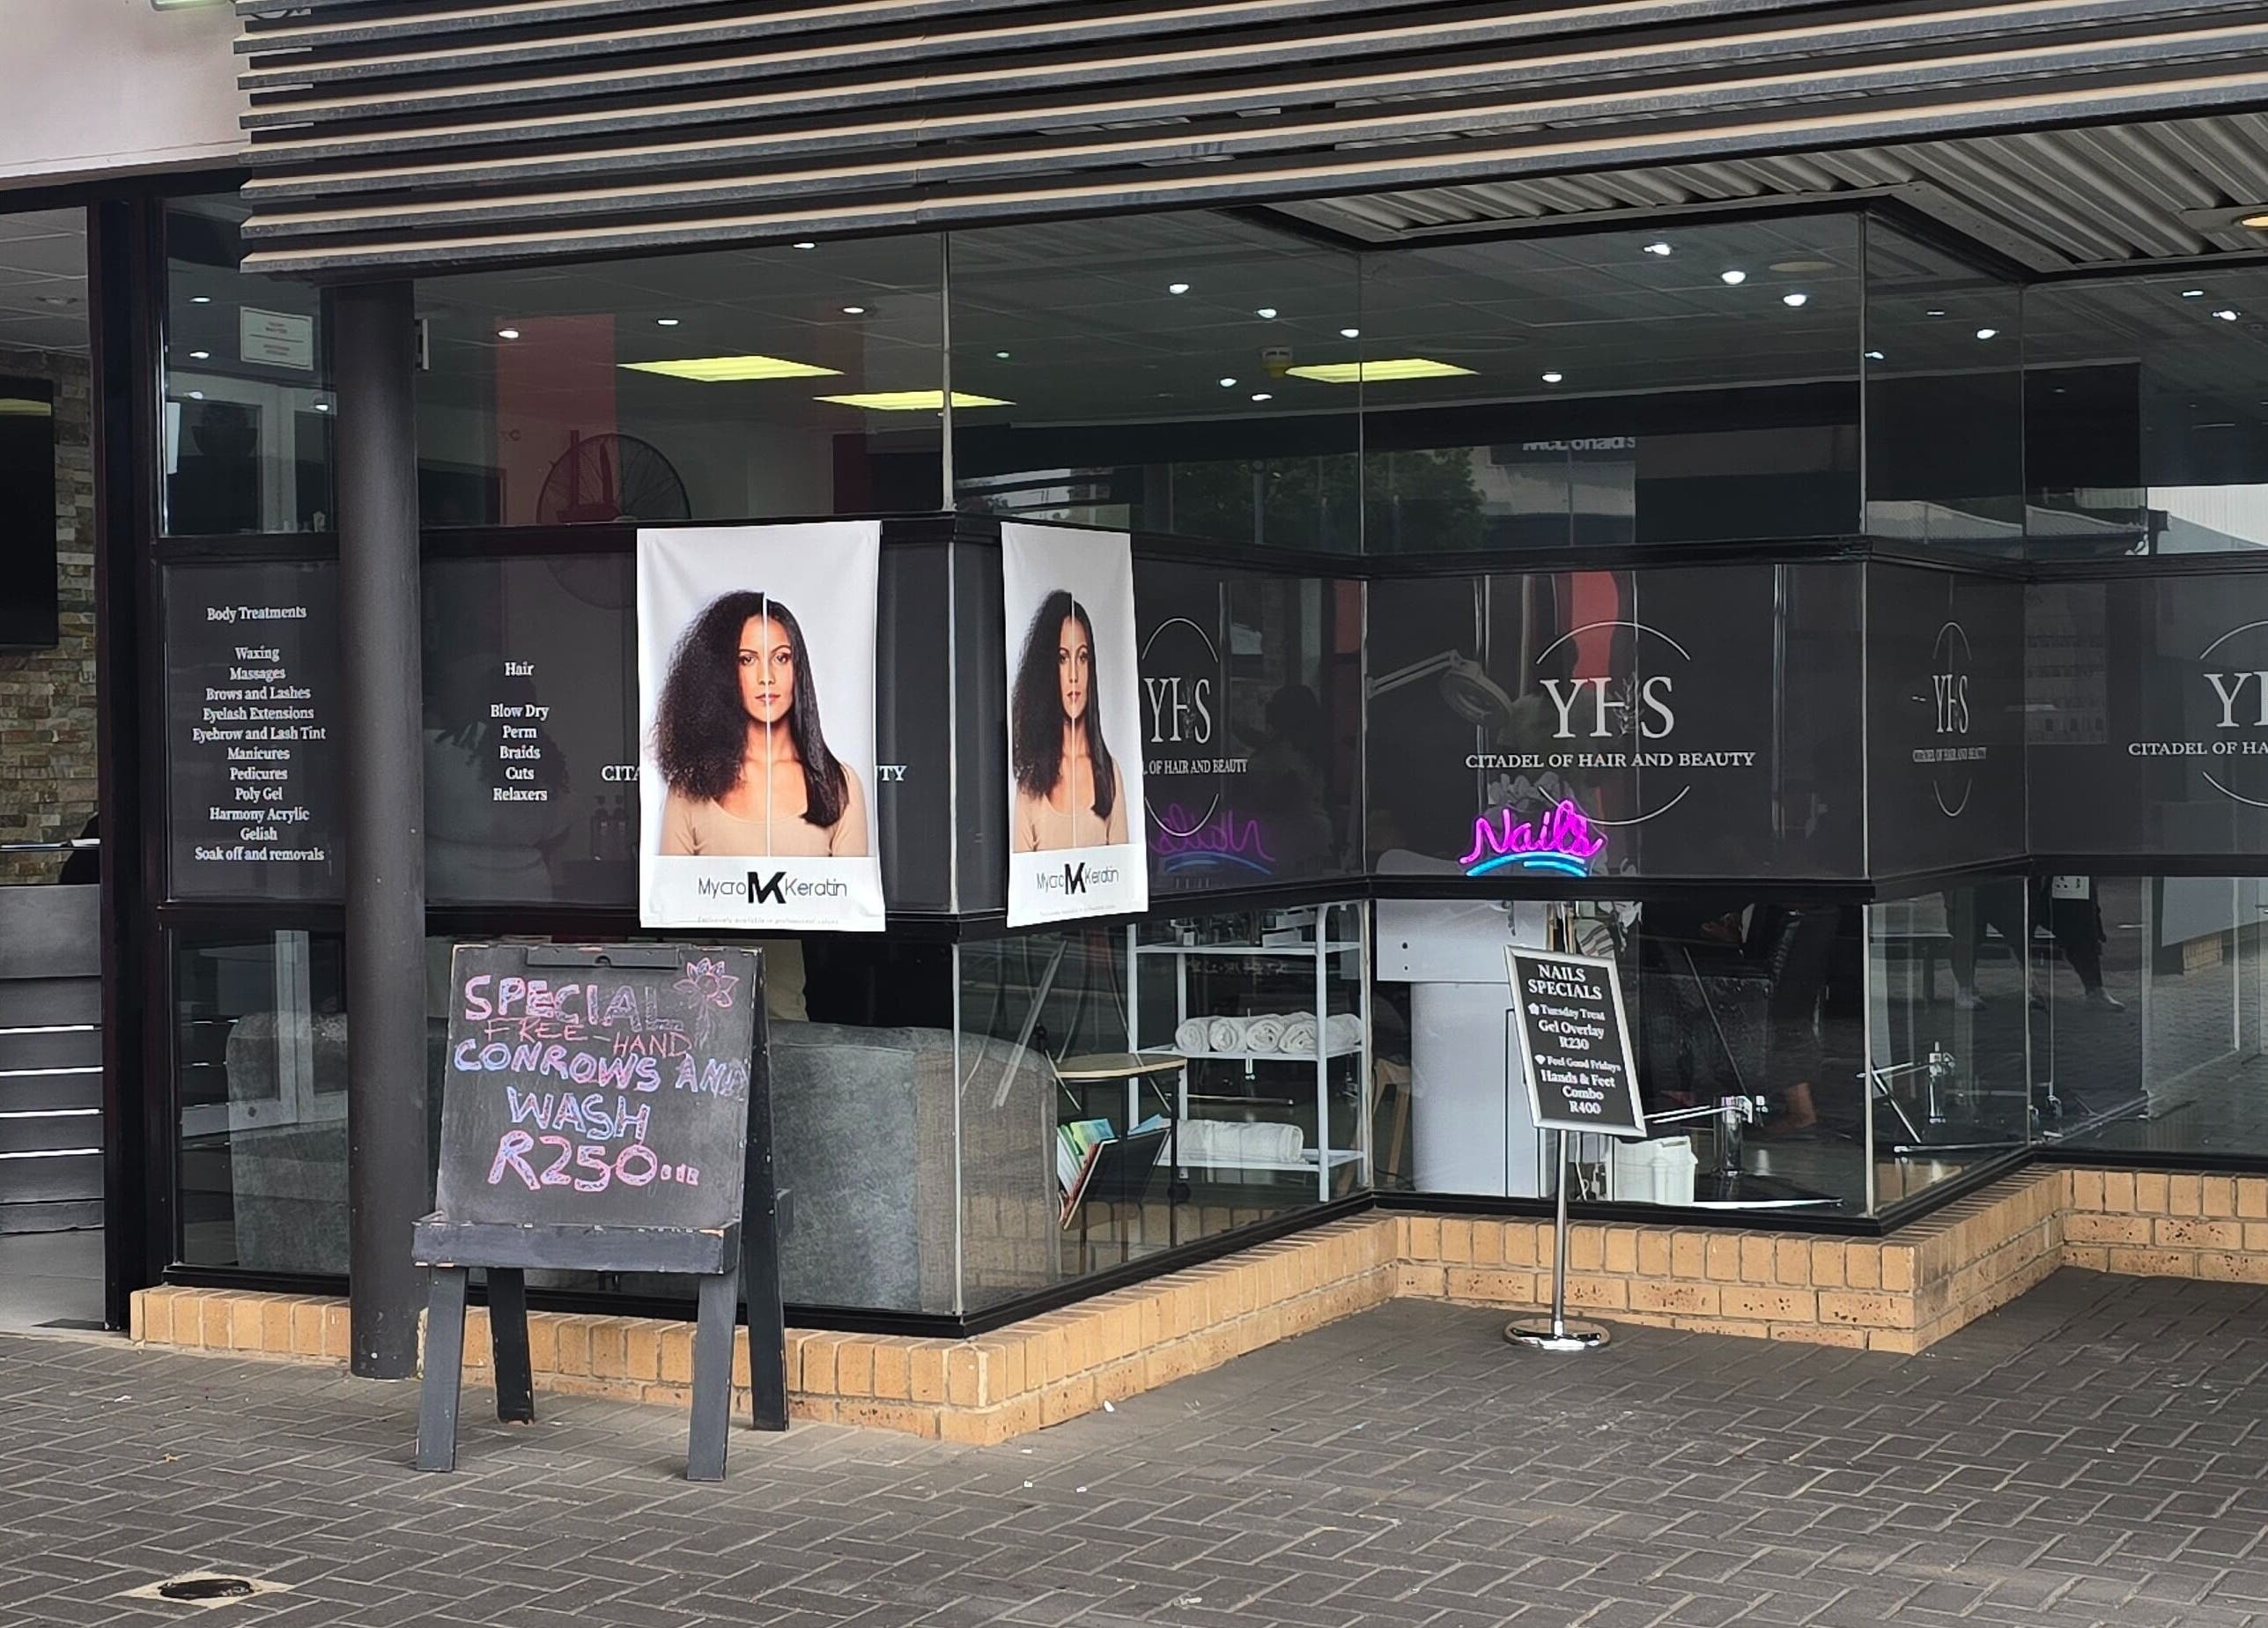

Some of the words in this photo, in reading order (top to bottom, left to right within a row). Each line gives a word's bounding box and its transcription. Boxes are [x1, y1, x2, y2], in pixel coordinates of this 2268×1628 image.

[206, 606, 236, 624] Body
[238, 605, 307, 619] Treatments
[234, 645, 280, 662] Waxing
[229, 667, 286, 683] Massages
[505, 661, 535, 676] Hair
[205, 687, 243, 701] Brows
[244, 685, 268, 700] and
[270, 684, 312, 699] Lashes
[203, 707, 247, 723] Eyelash
[249, 706, 314, 720] Extensions
[490, 703, 523, 718] Blow
[525, 704, 550, 722] Dry
[1143, 677, 1211, 744] YHS
[1540, 676, 1674, 738] YHS
[192, 727, 244, 744] Eyebrow
[245, 726, 268, 740] and
[270, 726, 299, 740] Lash
[300, 725, 327, 740] Tint
[502, 725, 537, 739] Perm
[226, 746, 291, 760] Manicures
[499, 744, 541, 759] Braids
[2128, 742, 2208, 756] CITADEL
[2212, 742, 2238, 755] OF
[2242, 741, 2268, 755] HA
[1149, 759, 1163, 775] OF
[1164, 759, 1189, 774] HAIR
[1190, 759, 1211, 773] AND
[1212, 758, 1248, 773] BEAUTY
[1465, 754, 1544, 768] CITADEL
[1548, 753, 1573, 768] OF
[1577, 753, 1627, 767] HAIR
[1631, 752, 1673, 767] AND
[1678, 751, 1756, 767] BEAUTY
[230, 766, 288, 781] Pedicures
[505, 766, 535, 780] Cuts
[234, 786, 261, 803] Poly
[262, 787, 283, 801] Gel
[493, 787, 548, 802] Relaxers
[209, 807, 266, 824] Harmony
[267, 806, 310, 825] Acrylic
[240, 826, 278, 840] Gelish
[1459, 799, 1603, 864] Nails
[195, 847, 225, 861] Soak
[225, 846, 244, 861] off
[244, 847, 268, 861] and
[270, 847, 325, 861] removals
[698, 876, 747, 899] Mycro
[785, 876, 847, 898] Keratin
[1537, 964, 1585, 982] NAILS
[1527, 980, 1602, 1000] SPECIALS
[464, 974, 684, 1032] SPECIAL
[1540, 1003, 1580, 1020] Tuesday
[1580, 1008, 1606, 1022] Treat
[1538, 1019, 1560, 1034] Gel
[1561, 1021, 1605, 1040] Overlay
[1558, 1036, 1590, 1050] R230
[454, 1039, 661, 1092] CONROWS
[1565, 1057, 1590, 1069] Good
[1591, 1059, 1622, 1073] Fridays
[1540, 1069, 1578, 1084] Hands
[1579, 1073, 1590, 1085] &
[1591, 1074, 1616, 1088] Feet
[1562, 1085, 1605, 1100] Combo
[506, 1086, 651, 1141] WASH
[1569, 1100, 1601, 1114] R400
